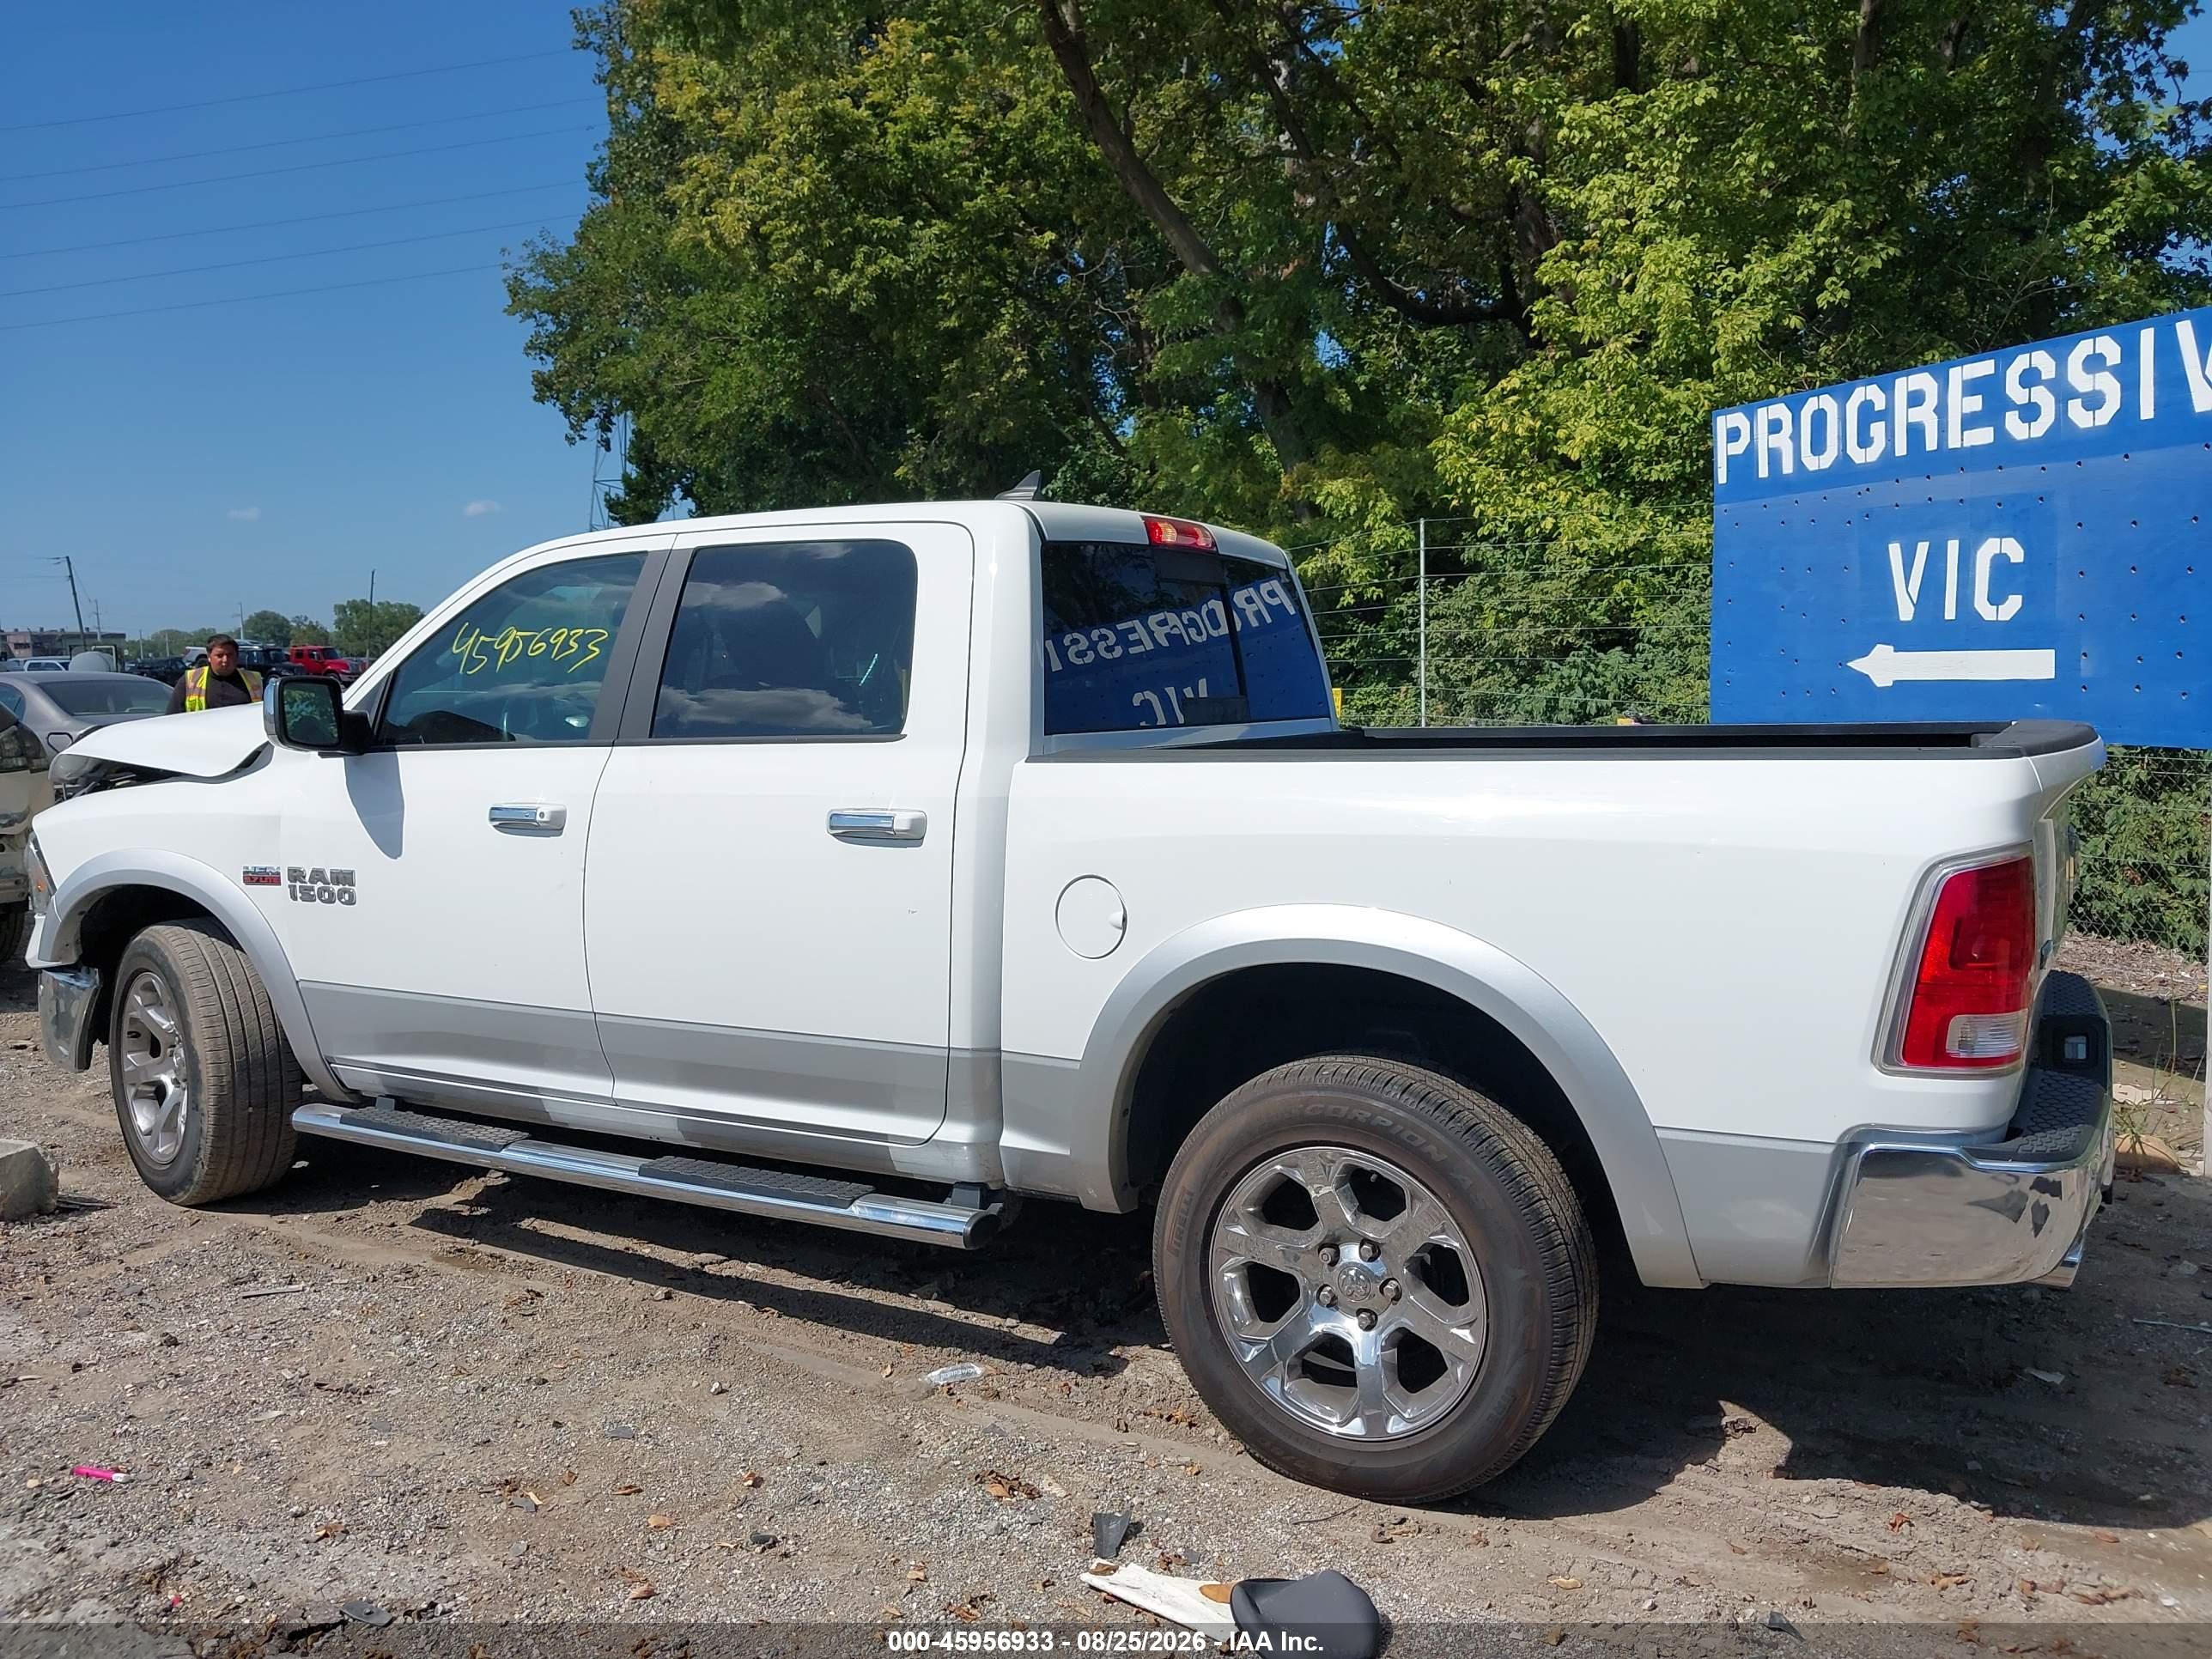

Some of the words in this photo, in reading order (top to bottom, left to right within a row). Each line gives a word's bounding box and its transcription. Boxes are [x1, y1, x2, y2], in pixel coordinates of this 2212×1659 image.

[1717, 319, 2212, 484] PROGRESSIV
[1888, 537, 2025, 622] VIC
[452, 622, 609, 675] 45956933
[287, 866, 356, 887] RAM
[288, 884, 357, 906] 1500
